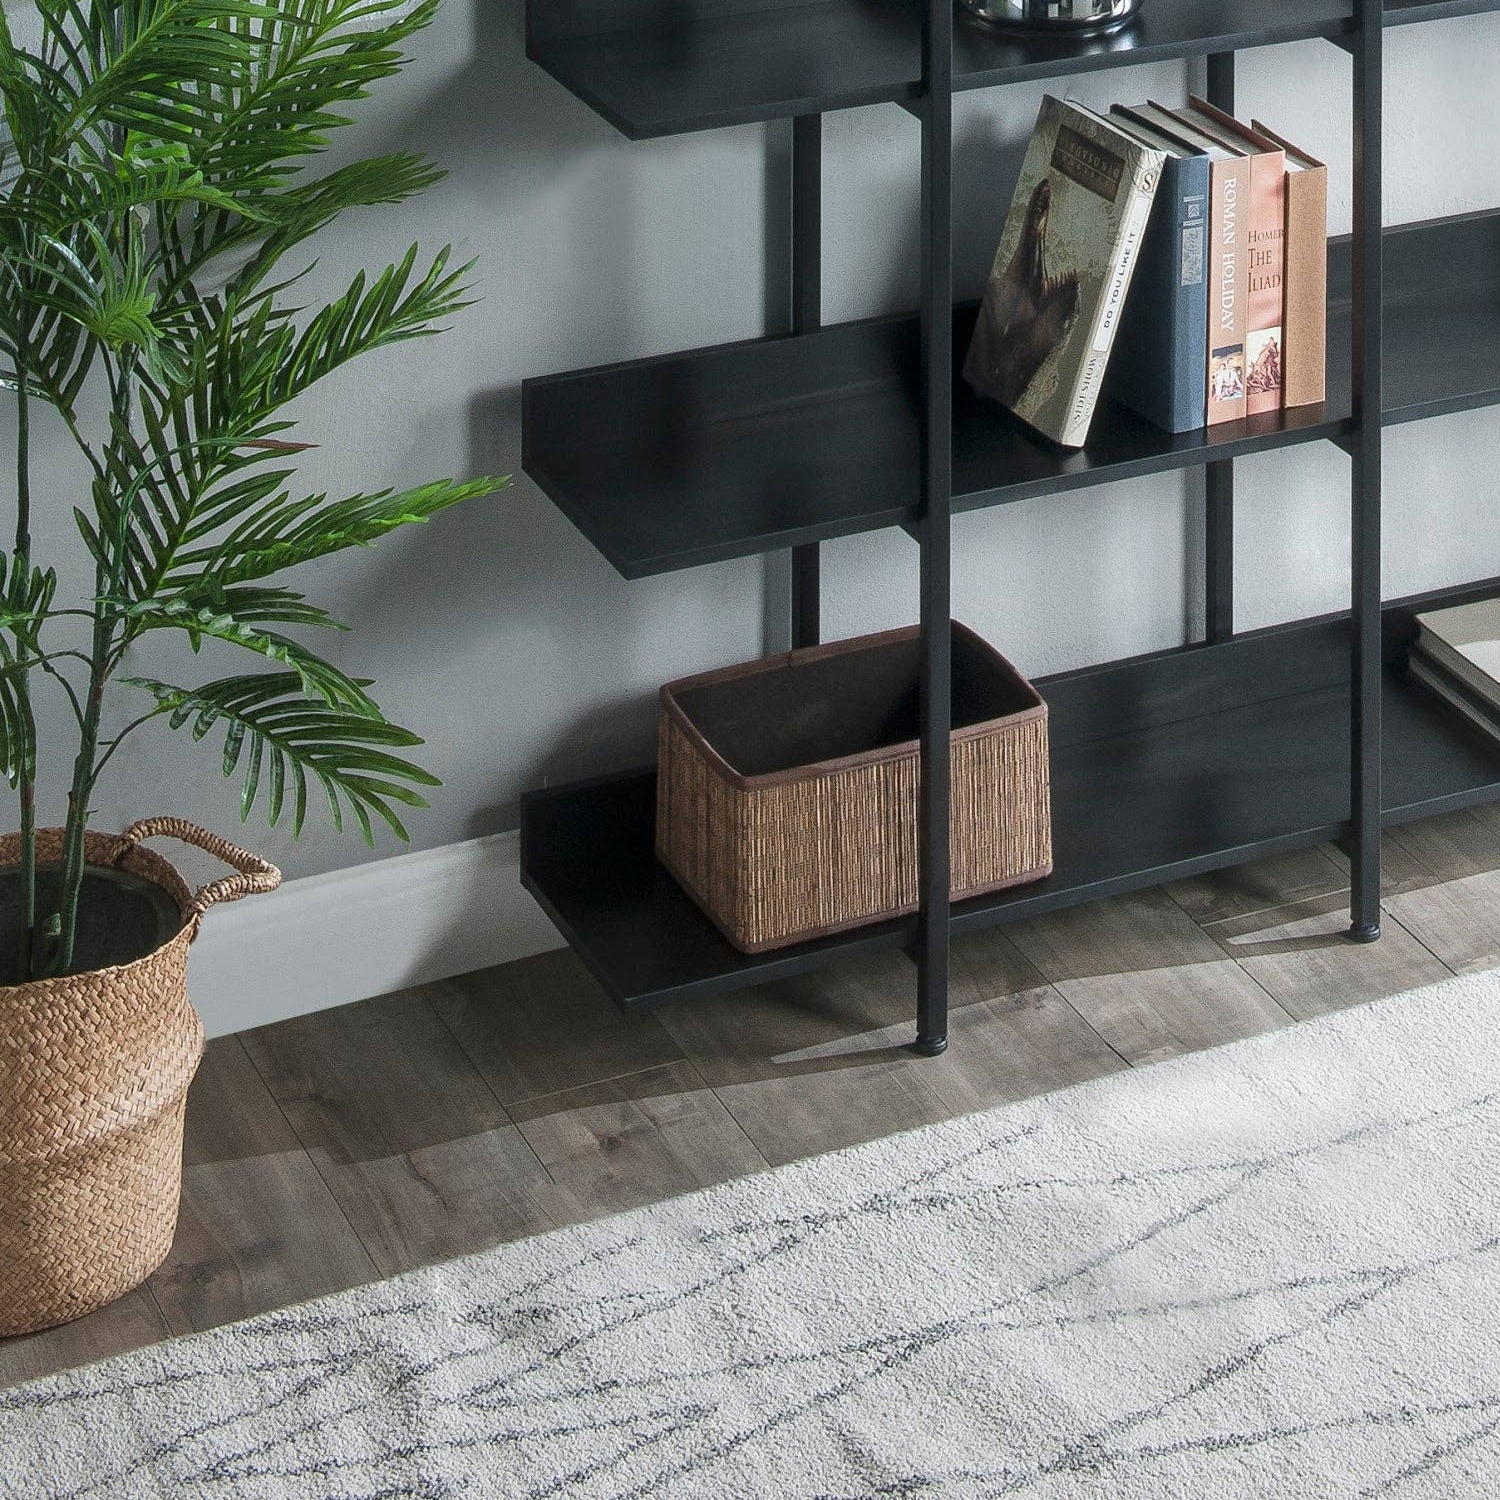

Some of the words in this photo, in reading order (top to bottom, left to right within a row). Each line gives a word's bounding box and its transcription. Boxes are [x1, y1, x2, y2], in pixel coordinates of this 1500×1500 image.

[1223, 177, 1237, 245] ROMAN
[1103, 309, 1113, 329] DO
[1109, 279, 1121, 305] YOU
[1118, 248, 1131, 276] LIKE
[1127, 232, 1136, 243] IT
[1220, 252, 1236, 332] HOLIDAY
